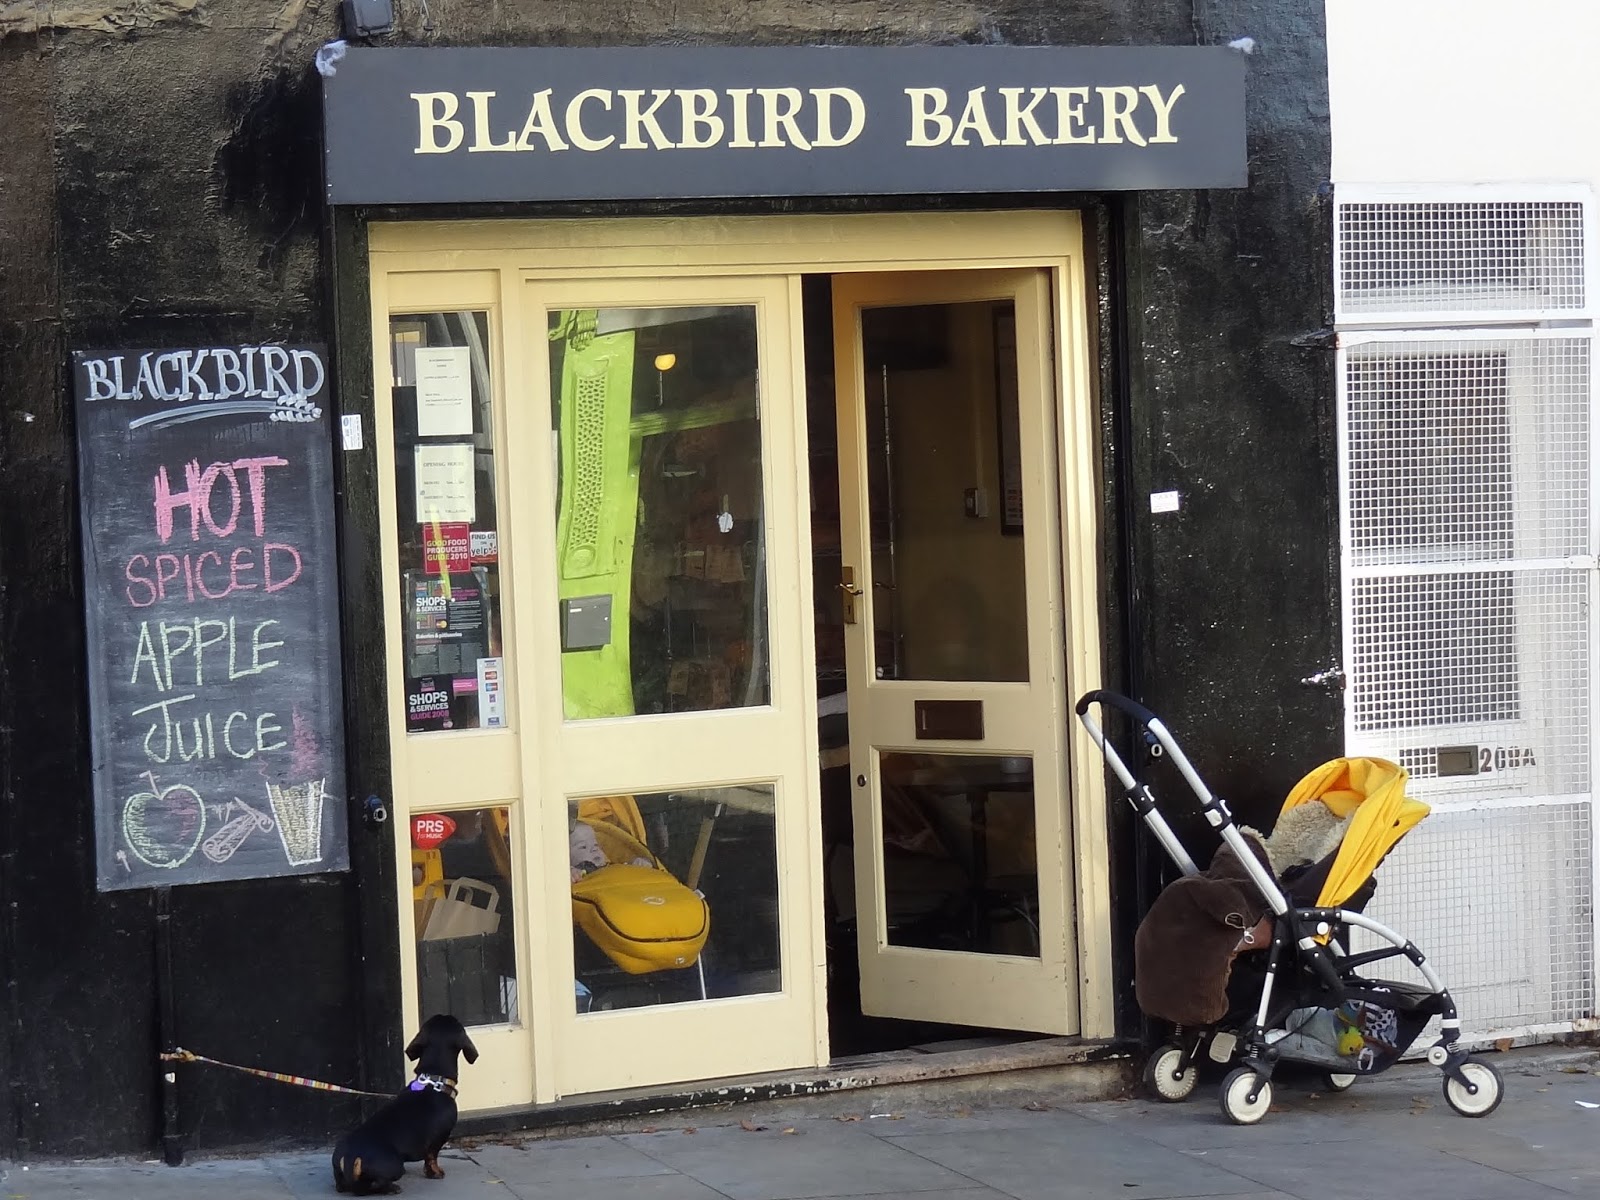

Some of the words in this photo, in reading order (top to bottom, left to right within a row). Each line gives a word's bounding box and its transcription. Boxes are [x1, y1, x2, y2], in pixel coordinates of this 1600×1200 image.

[410, 87, 866, 154] BLACKBIRD
[904, 83, 1186, 147] BAKERY
[83, 346, 325, 401] BLACKBIRD
[154, 456, 288, 544] HOT
[447, 538, 467, 546] FOOD
[426, 546, 468, 554] PRODUCERS
[450, 552, 468, 560] 2010
[471, 547, 489, 556] yelp
[125, 543, 302, 607] SPICED
[416, 596, 446, 607] SHOPS
[131, 616, 285, 692] APPLE
[409, 691, 448, 706] SHOPS
[416, 702, 449, 711] SERVICES
[410, 712, 432, 720] GUIDE
[132, 694, 288, 763] JUICE
[1480, 746, 1536, 772] 208A
[417, 820, 444, 832] PRS
